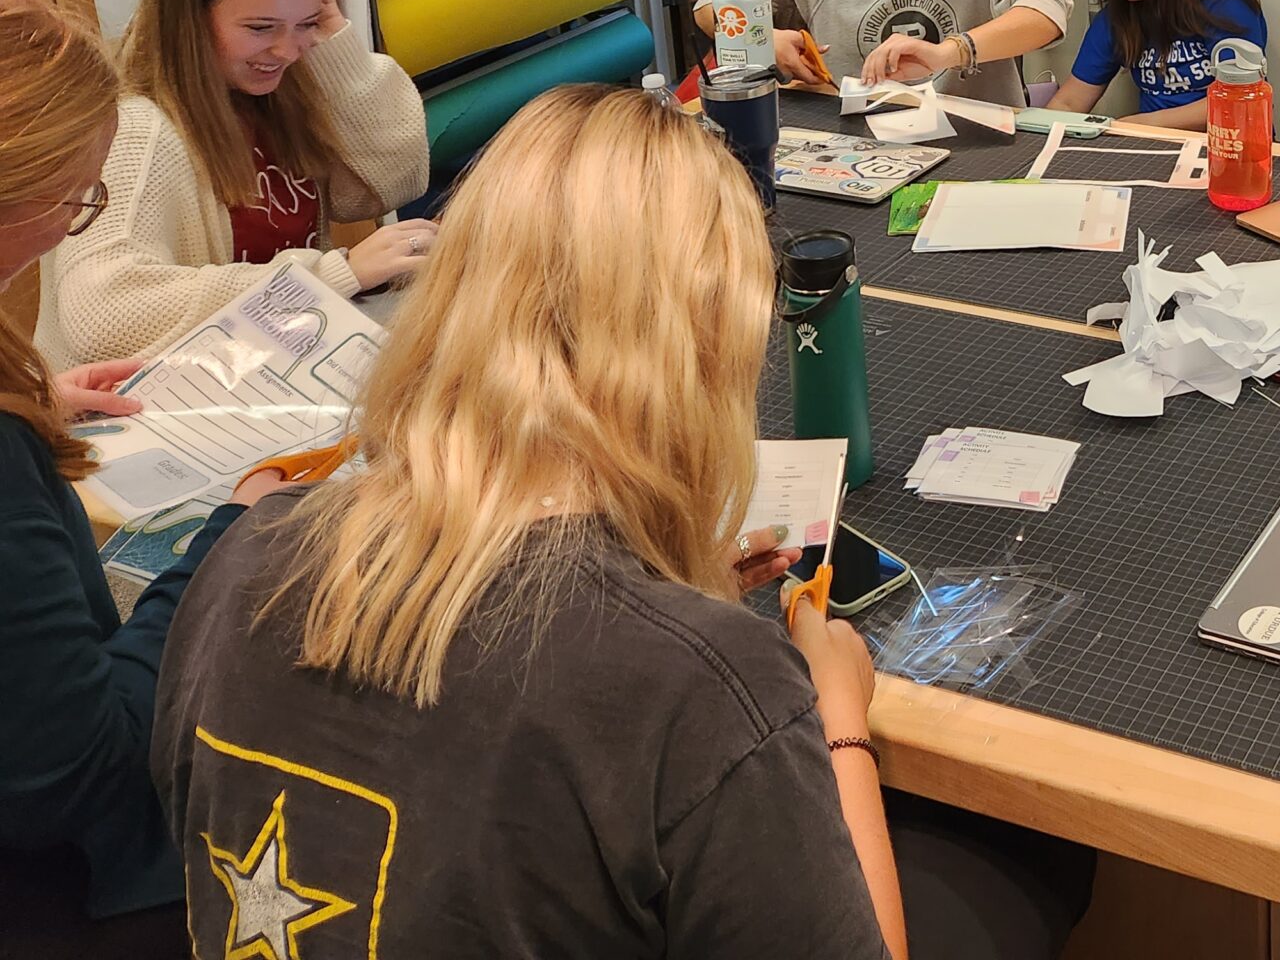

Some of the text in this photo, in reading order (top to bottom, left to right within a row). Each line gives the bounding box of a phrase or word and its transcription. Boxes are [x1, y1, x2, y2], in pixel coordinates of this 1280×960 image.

[863, 3, 891, 42] PURDUE
[1141, 69, 1156, 85] 19
[1190, 59, 1212, 81] 58
[862, 162, 905, 176] 101
[269, 275, 321, 313] DAILY
[327, 359, 337, 368] Did
